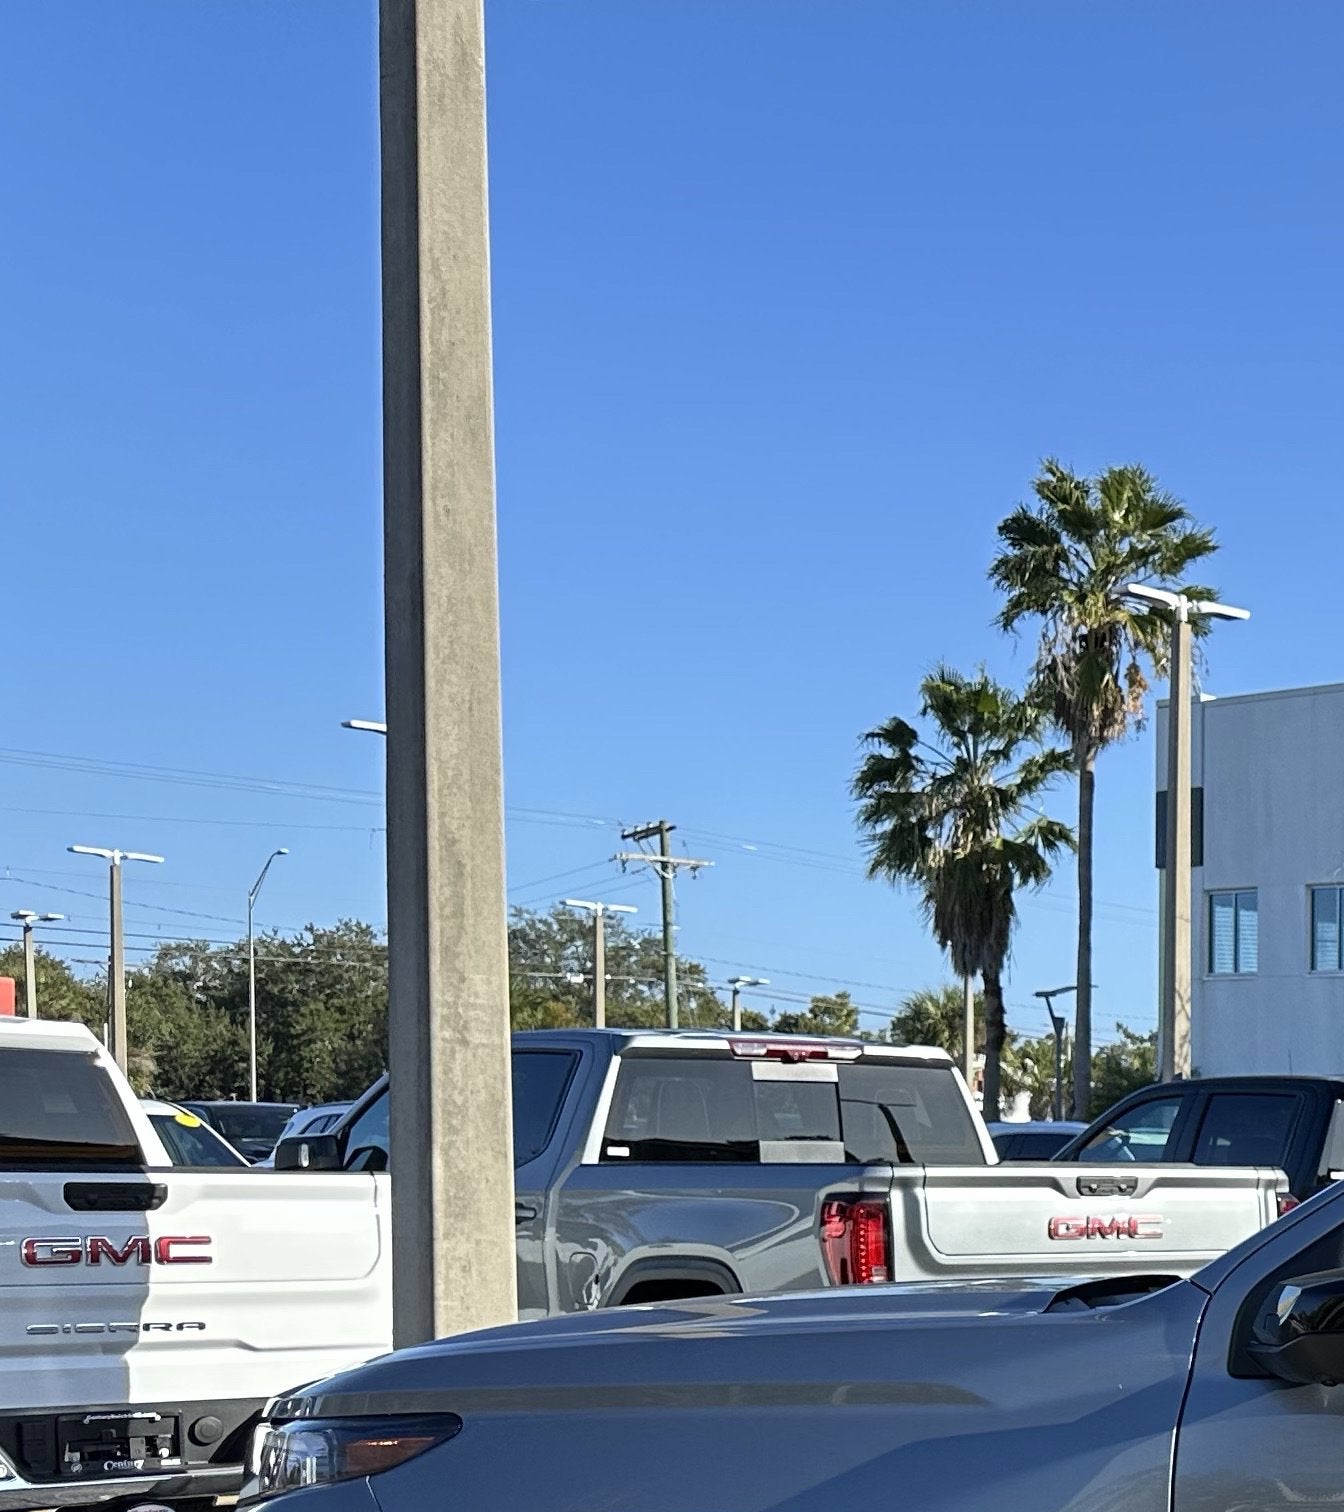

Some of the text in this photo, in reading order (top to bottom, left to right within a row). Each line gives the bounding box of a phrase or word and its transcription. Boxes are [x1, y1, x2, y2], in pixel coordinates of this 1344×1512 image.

[1047, 1214, 1164, 1241] GMC
[21, 1235, 212, 1267] GMC
[26, 1322, 206, 1335] SIERRA
